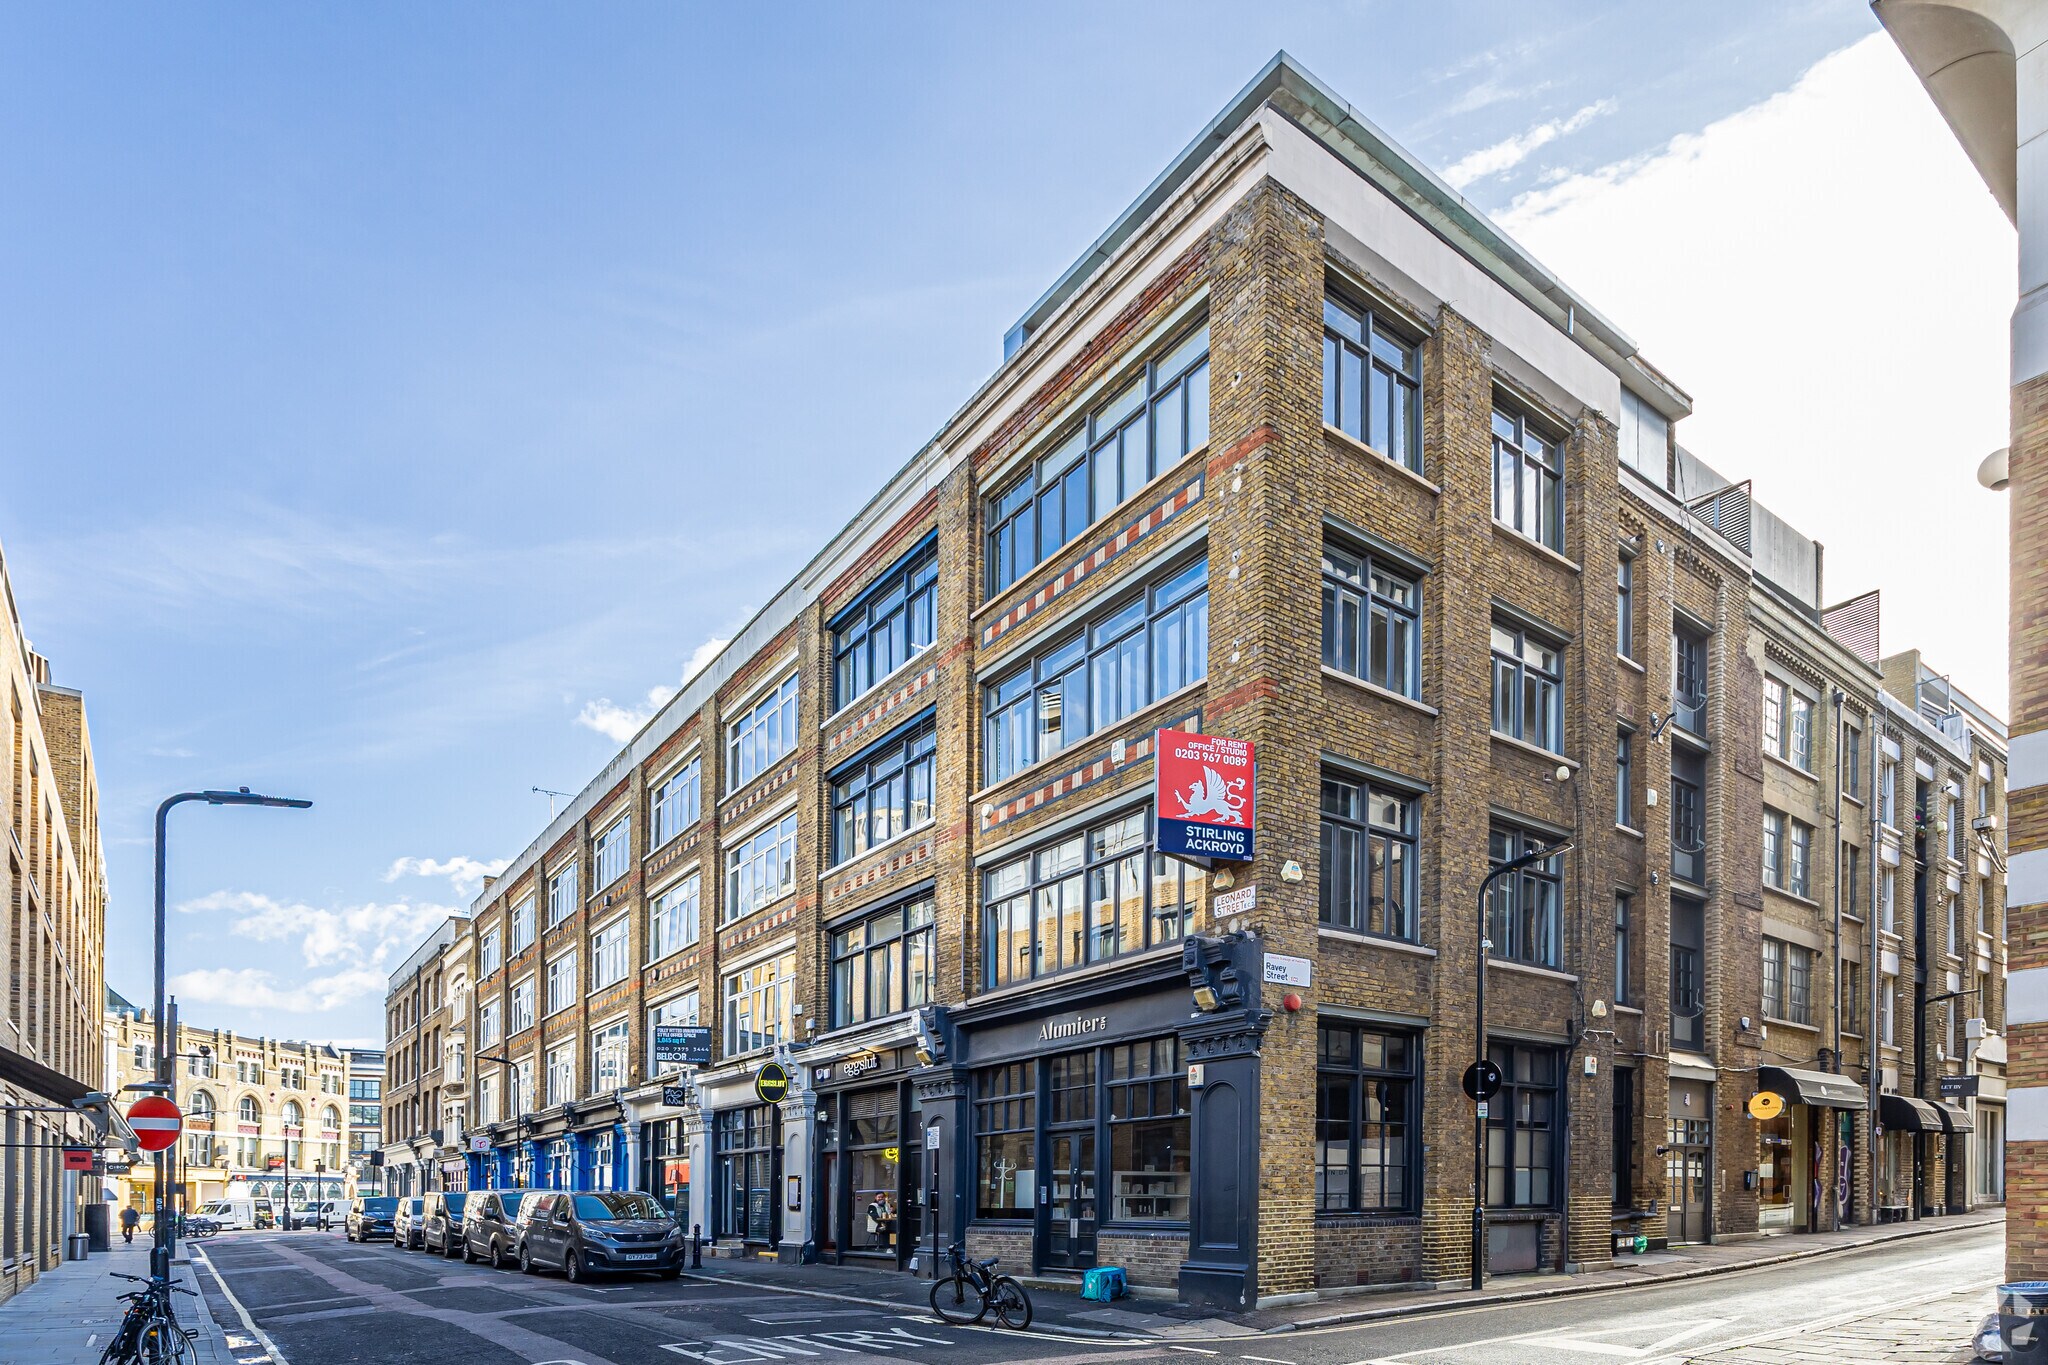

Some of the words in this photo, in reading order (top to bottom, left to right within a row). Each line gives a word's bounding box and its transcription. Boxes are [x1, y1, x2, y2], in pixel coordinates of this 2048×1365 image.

[1188, 742, 1214, 752] OFFICE
[1221, 746, 1247, 757] STUDIO
[1212, 738, 1226, 747] FOR
[1228, 740, 1247, 750] RENT
[1175, 748, 1200, 760] 0203
[1202, 752, 1221, 763] 967
[1223, 755, 1247, 766] 0089
[1186, 826, 1245, 842] STIRLING
[1186, 838, 1245, 854] ACKROYD
[1216, 889, 1251, 906] LEONARD
[1217, 901, 1244, 916] STREET
[1266, 962, 1286, 974] Ravey
[1266, 971, 1288, 980] Street
[1038, 1016, 1100, 1041] Alumier
[843, 1054, 877, 1076] eggslut
[659, 1327, 955, 1364] ENTRY
